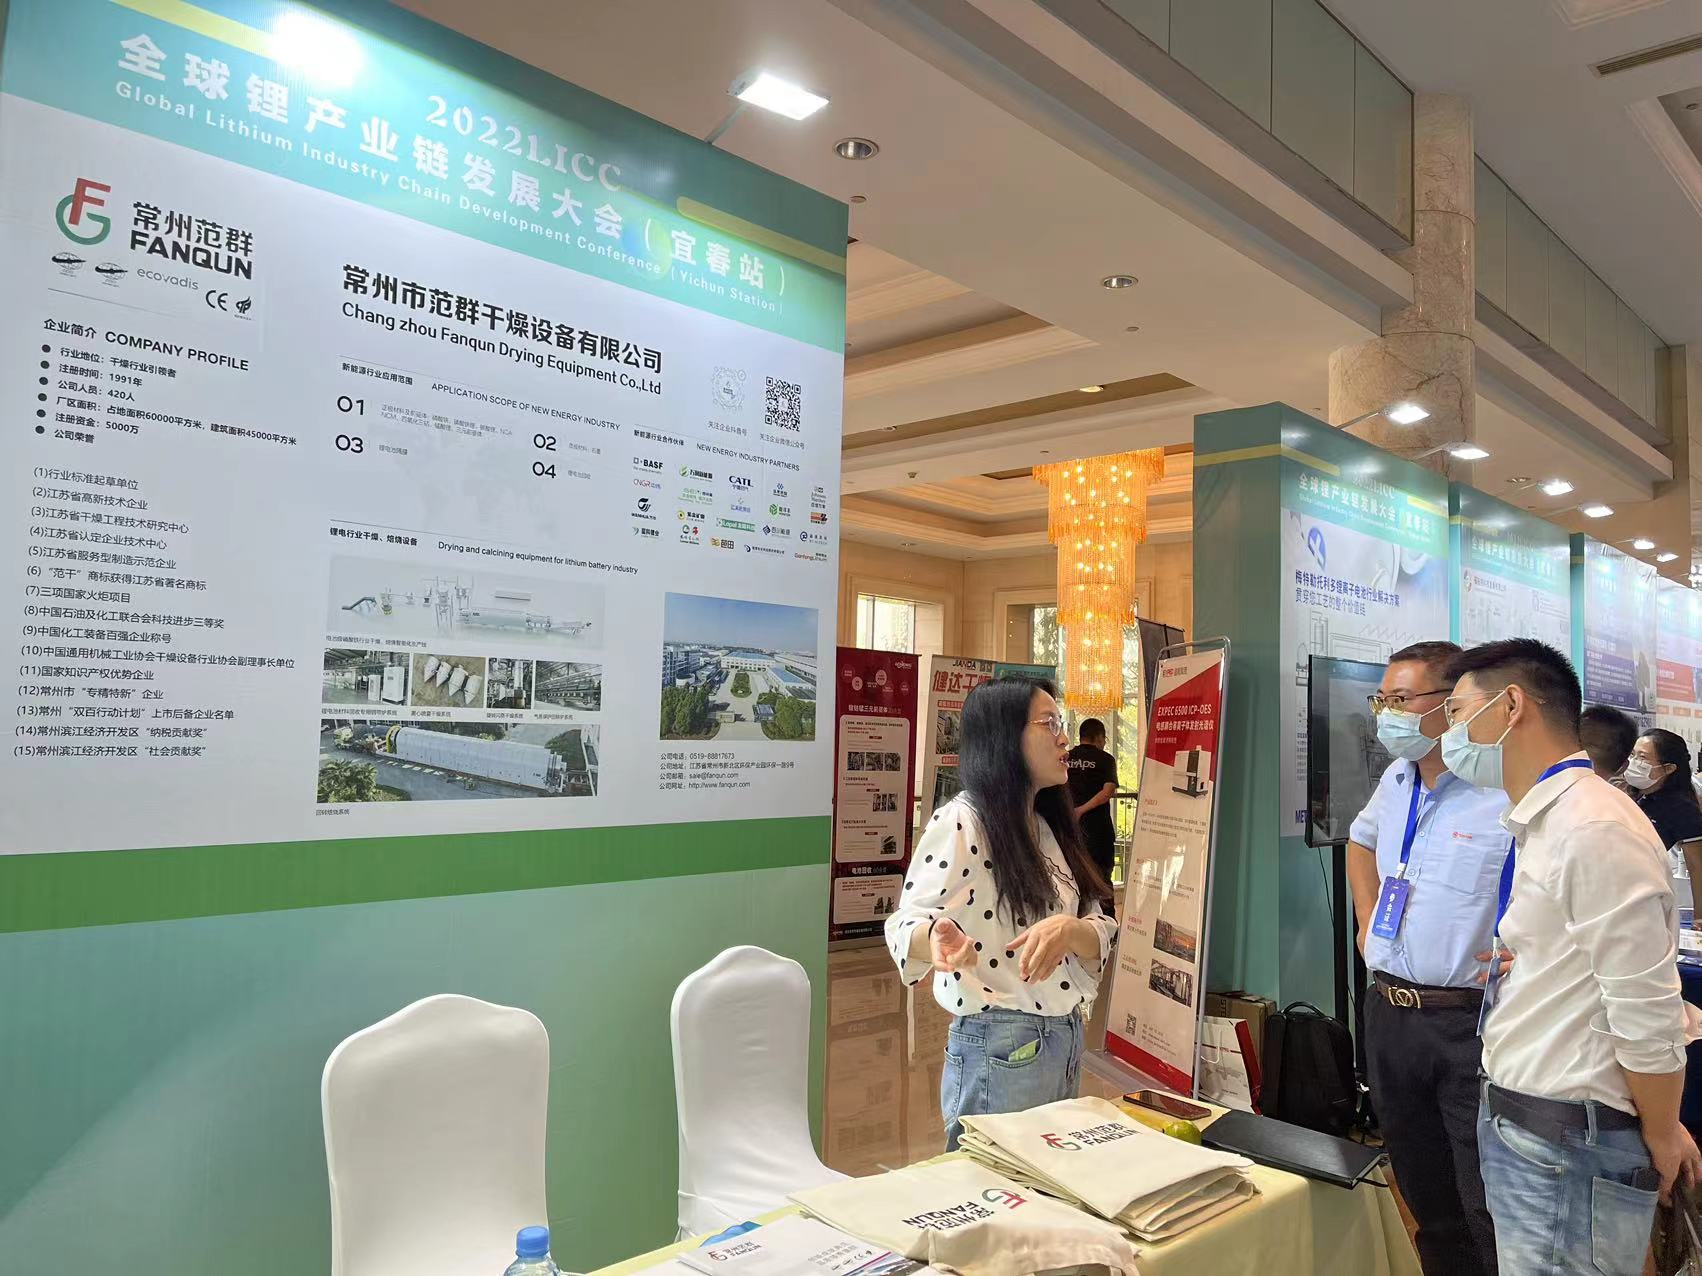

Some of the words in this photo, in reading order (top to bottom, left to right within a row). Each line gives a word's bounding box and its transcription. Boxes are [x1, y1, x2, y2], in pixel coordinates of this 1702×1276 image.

[425, 95, 621, 192] 2022LICC
[116, 81, 194, 119] Global
[206, 110, 293, 151] Lithium
[303, 142, 390, 185] Industry
[398, 175, 451, 204] Chain
[460, 196, 571, 244] Development
[577, 237, 661, 274] Conference
[132, 201, 254, 257] 常州范群
[130, 229, 252, 280] FANQUN
[136, 267, 199, 290] ecovadis
[342, 263, 662, 375] 常州市范群干燥设备有限公司
[43, 318, 97, 340] 企业简介
[104, 331, 184, 356] COMPANY
[187, 348, 249, 371] PROFILE
[342, 302, 395, 331] Chang
[399, 318, 437, 340] zhou
[441, 327, 496, 358] Fanqun
[499, 341, 545, 368] Drying
[547, 354, 617, 385] Equipment
[337, 395, 365, 415] 01
[342, 362, 413, 386] 新能源行业应用范围
[431, 383, 488, 402] APPLICATION
[489, 395, 517, 409] SCOPE
[518, 402, 530, 411] OF
[531, 405, 550, 415] NEW
[551, 409, 582, 422] ENERGY
[583, 416, 621, 431] INDUSTRY
[54, 429, 95, 445] 公司荣誉
[335, 434, 364, 454] 03
[533, 433, 557, 452] 02
[643, 458, 664, 469] BASF
[696, 443, 711, 452] NEW
[712, 446, 738, 459] ENERGY
[738, 451, 769, 465] INDUSTRY
[769, 458, 800, 471] PARTNERS
[33, 467, 139, 491] (1)行业标准起草单位
[532, 461, 557, 479] 04
[728, 475, 754, 488] CATL
[32, 486, 148, 510] (2)江苏省高新技术企业
[31, 506, 190, 534] (3)江苏省干燥工程技术研究中心
[29, 526, 168, 550] (4)江苏省认定企业技术中心
[28, 545, 177, 570] (5)江苏省服务型制造示范企业
[438, 541, 464, 553] Drying
[465, 545, 480, 554] and
[481, 547, 515, 559] calcining
[515, 552, 553, 564] equipment
[553, 556, 564, 565] for
[565, 557, 587, 568] lithium
[588, 560, 611, 571] battery
[612, 563, 639, 575] industry
[25, 585, 131, 603] (7)三项国家火炬项目
[22, 625, 172, 644] (9)中国化工装备百强企业称号
[19, 665, 155, 681] (11)国家知识产权优势企业
[1157, 705, 1175, 717] EXPEC
[1188, 703, 1213, 715] ICP-OES
[901, 1201, 980, 1226] FANQUN
